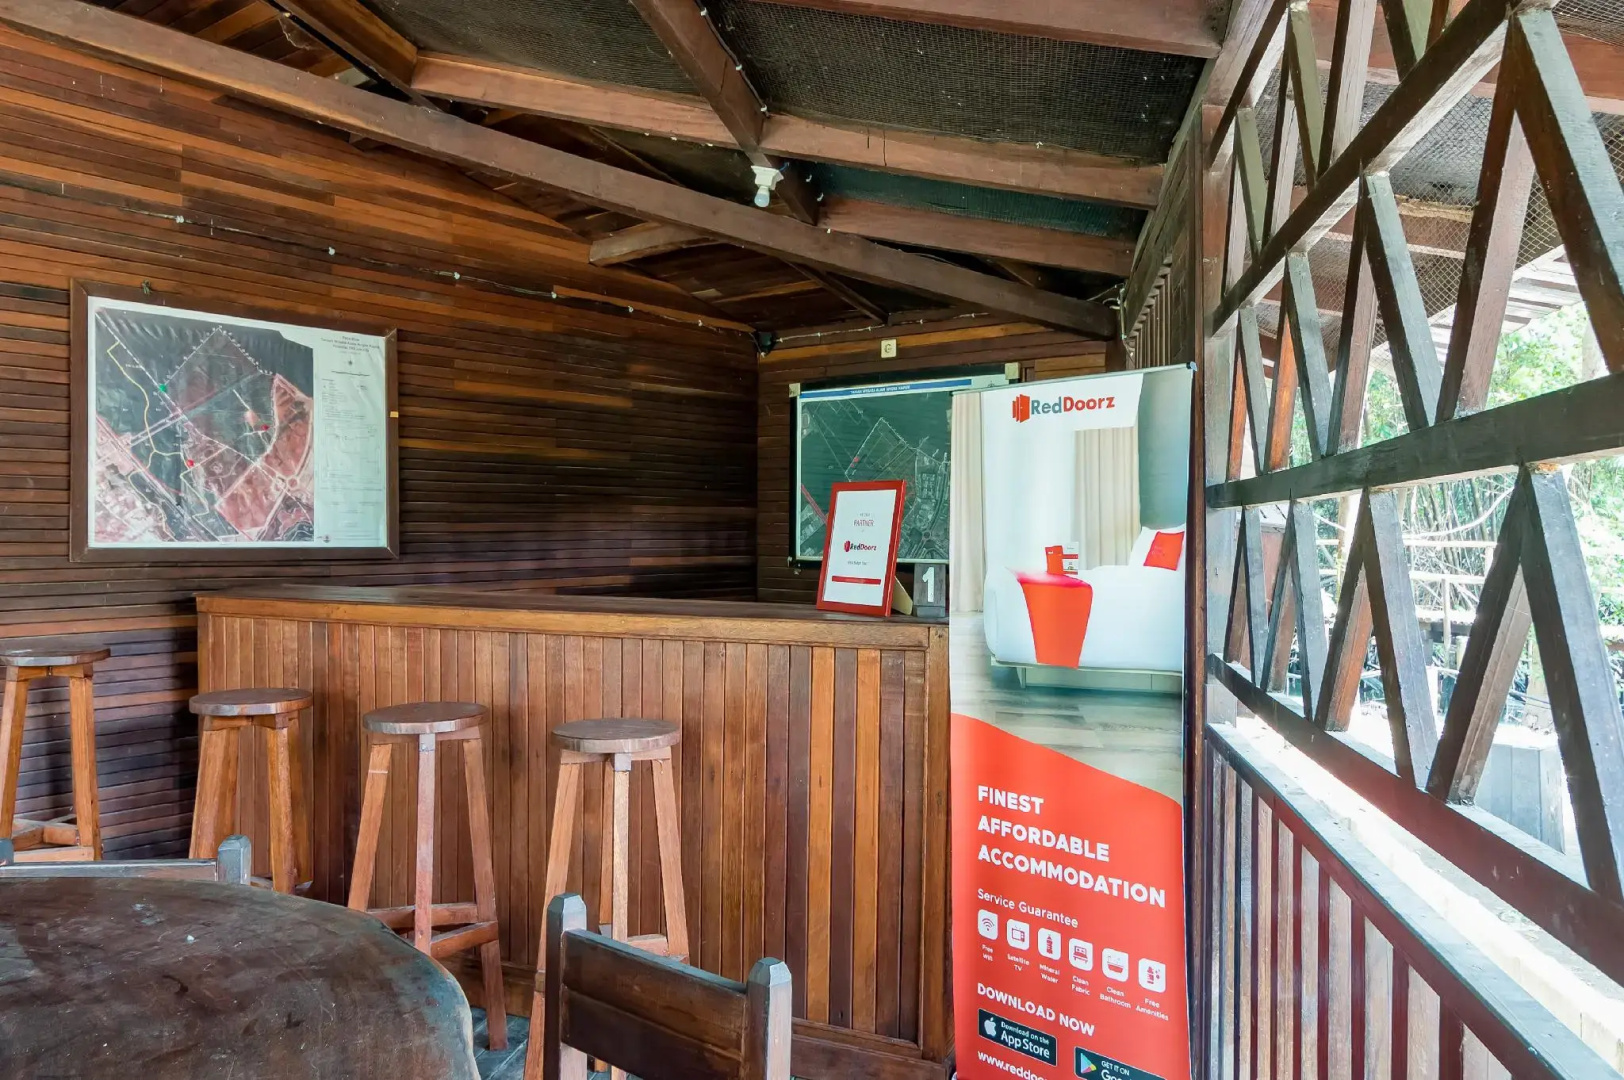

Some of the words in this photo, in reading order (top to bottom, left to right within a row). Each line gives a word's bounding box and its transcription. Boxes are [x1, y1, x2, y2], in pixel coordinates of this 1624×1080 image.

[1031, 396, 1115, 414] RedDoorz
[922, 566, 935, 602] 1
[978, 785, 1044, 814] FINEST
[978, 816, 1110, 862] AFFORDABLE
[978, 844, 1166, 908] ACCOMMODATION
[978, 889, 1015, 910] Service
[1018, 901, 1078, 928] Guarantee
[982, 944, 994, 953] Free
[1039, 964, 1060, 975] Mineral
[1071, 984, 1090, 995] Fabric
[1072, 976, 1089, 986] Clean
[1106, 986, 1125, 997] Clean
[978, 983, 1056, 1021] DOWNLOAD
[1059, 1012, 1095, 1037] NOW
[1100, 994, 1131, 1009] Bathroom
[1144, 998, 1160, 1008] Free
[1136, 1005, 1169, 1021] Amenities
[1001, 1020, 1028, 1038] Download
[1030, 1030, 1038, 1041] on
[1039, 1033, 1050, 1045] the
[1001, 1031, 1022, 1049] App
[1022, 1036, 1050, 1059] Store
[1101, 1061, 1113, 1070] GET
[1114, 1064, 1119, 1073] IT
[1120, 1068, 1130, 1076] ON
